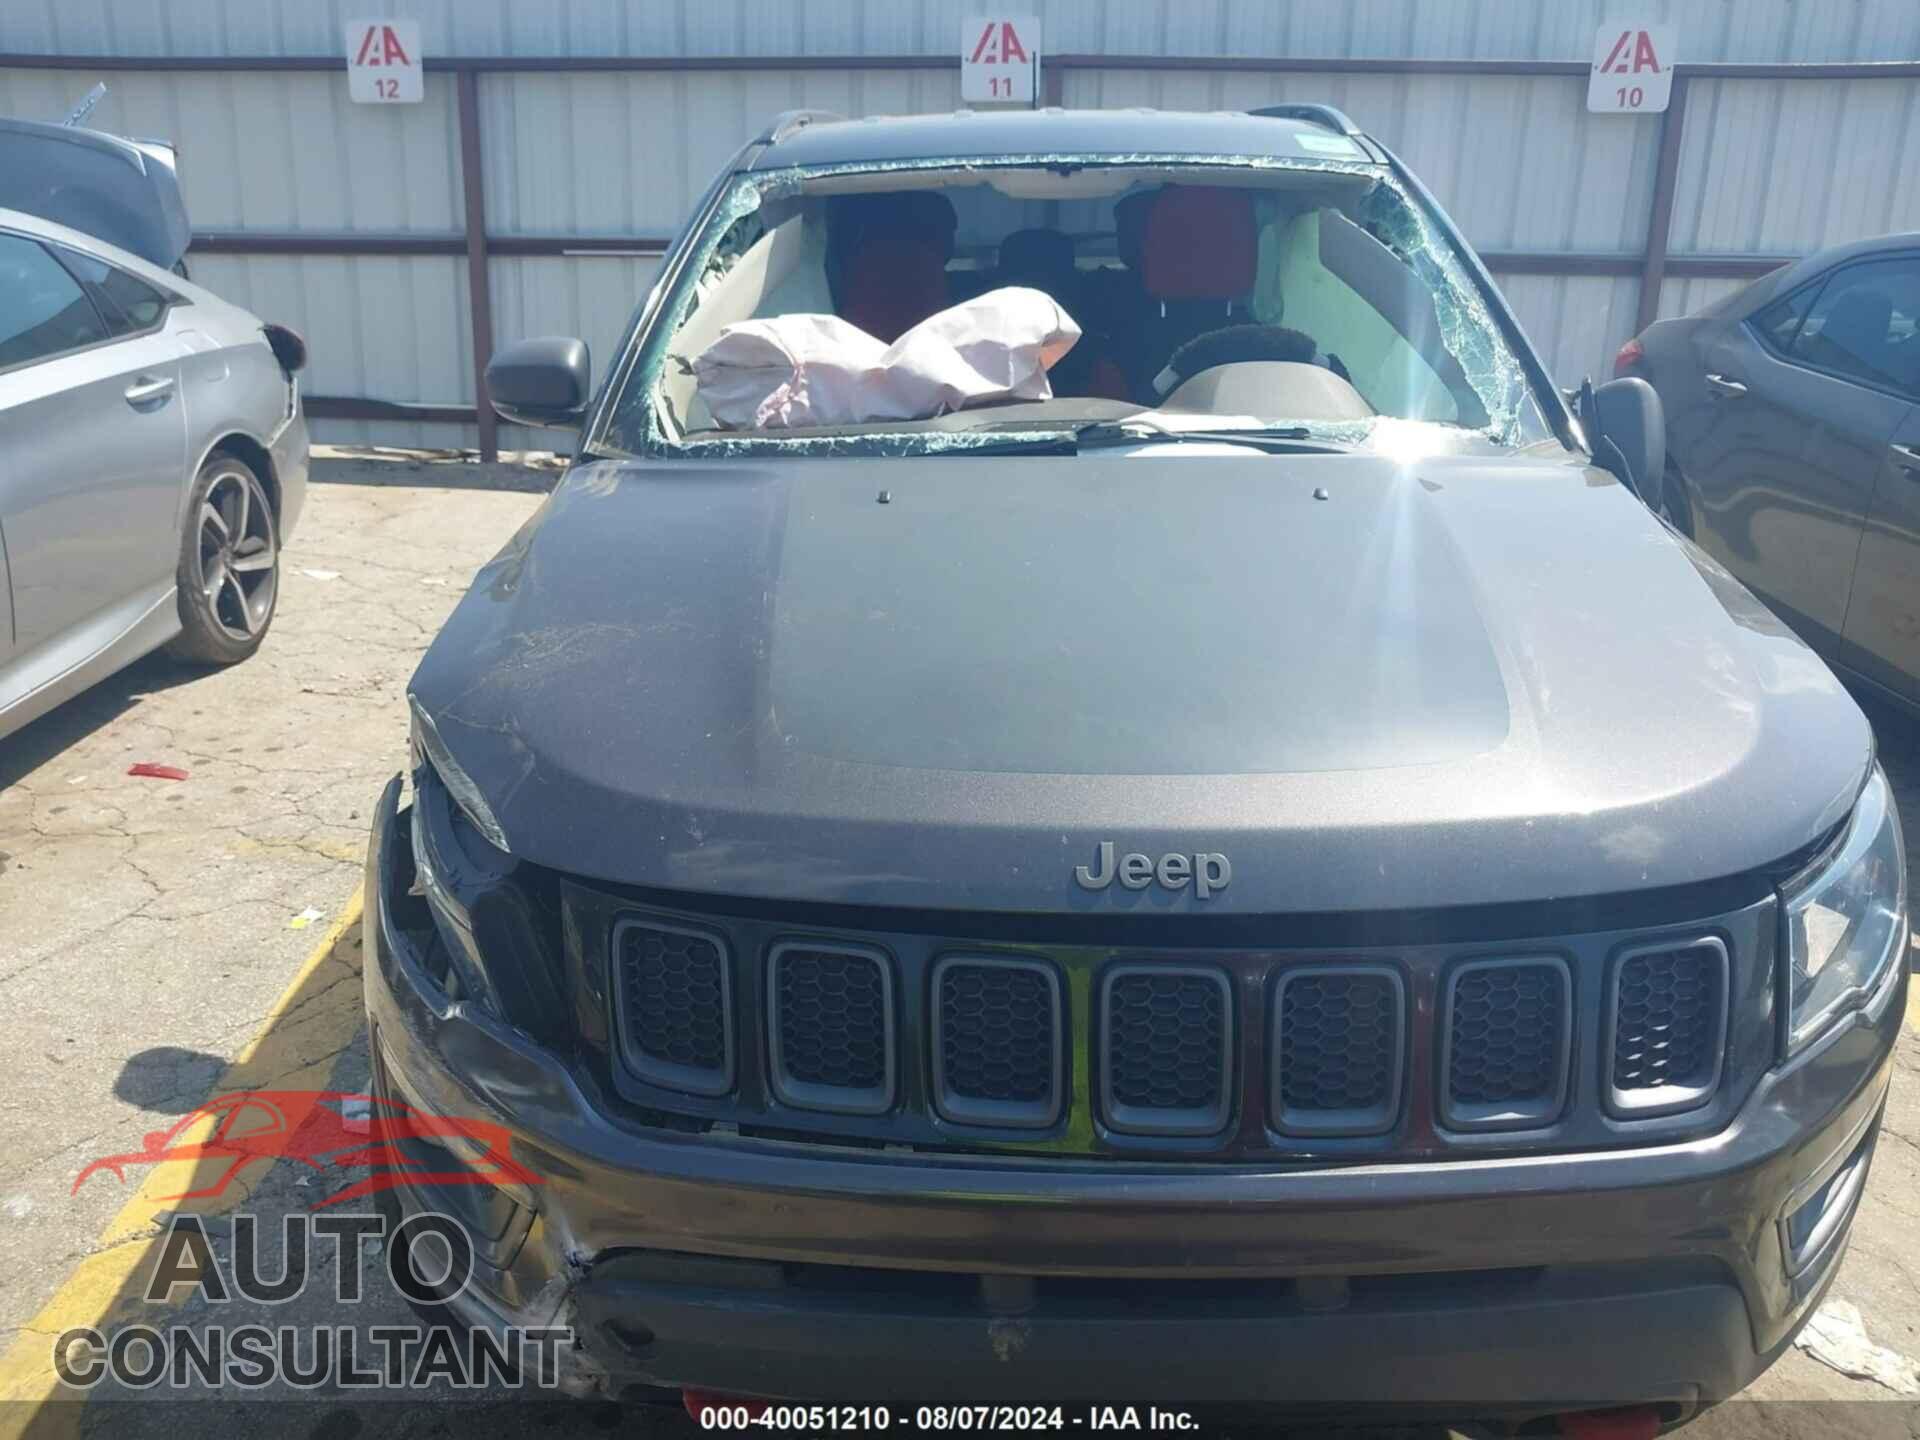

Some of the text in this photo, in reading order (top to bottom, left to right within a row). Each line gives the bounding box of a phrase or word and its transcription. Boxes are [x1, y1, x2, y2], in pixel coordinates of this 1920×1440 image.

[374, 78, 400, 98] 12
[989, 77, 1011, 97] 11
[1616, 87, 1643, 108] 10
[1074, 841, 1232, 899] Jeep
